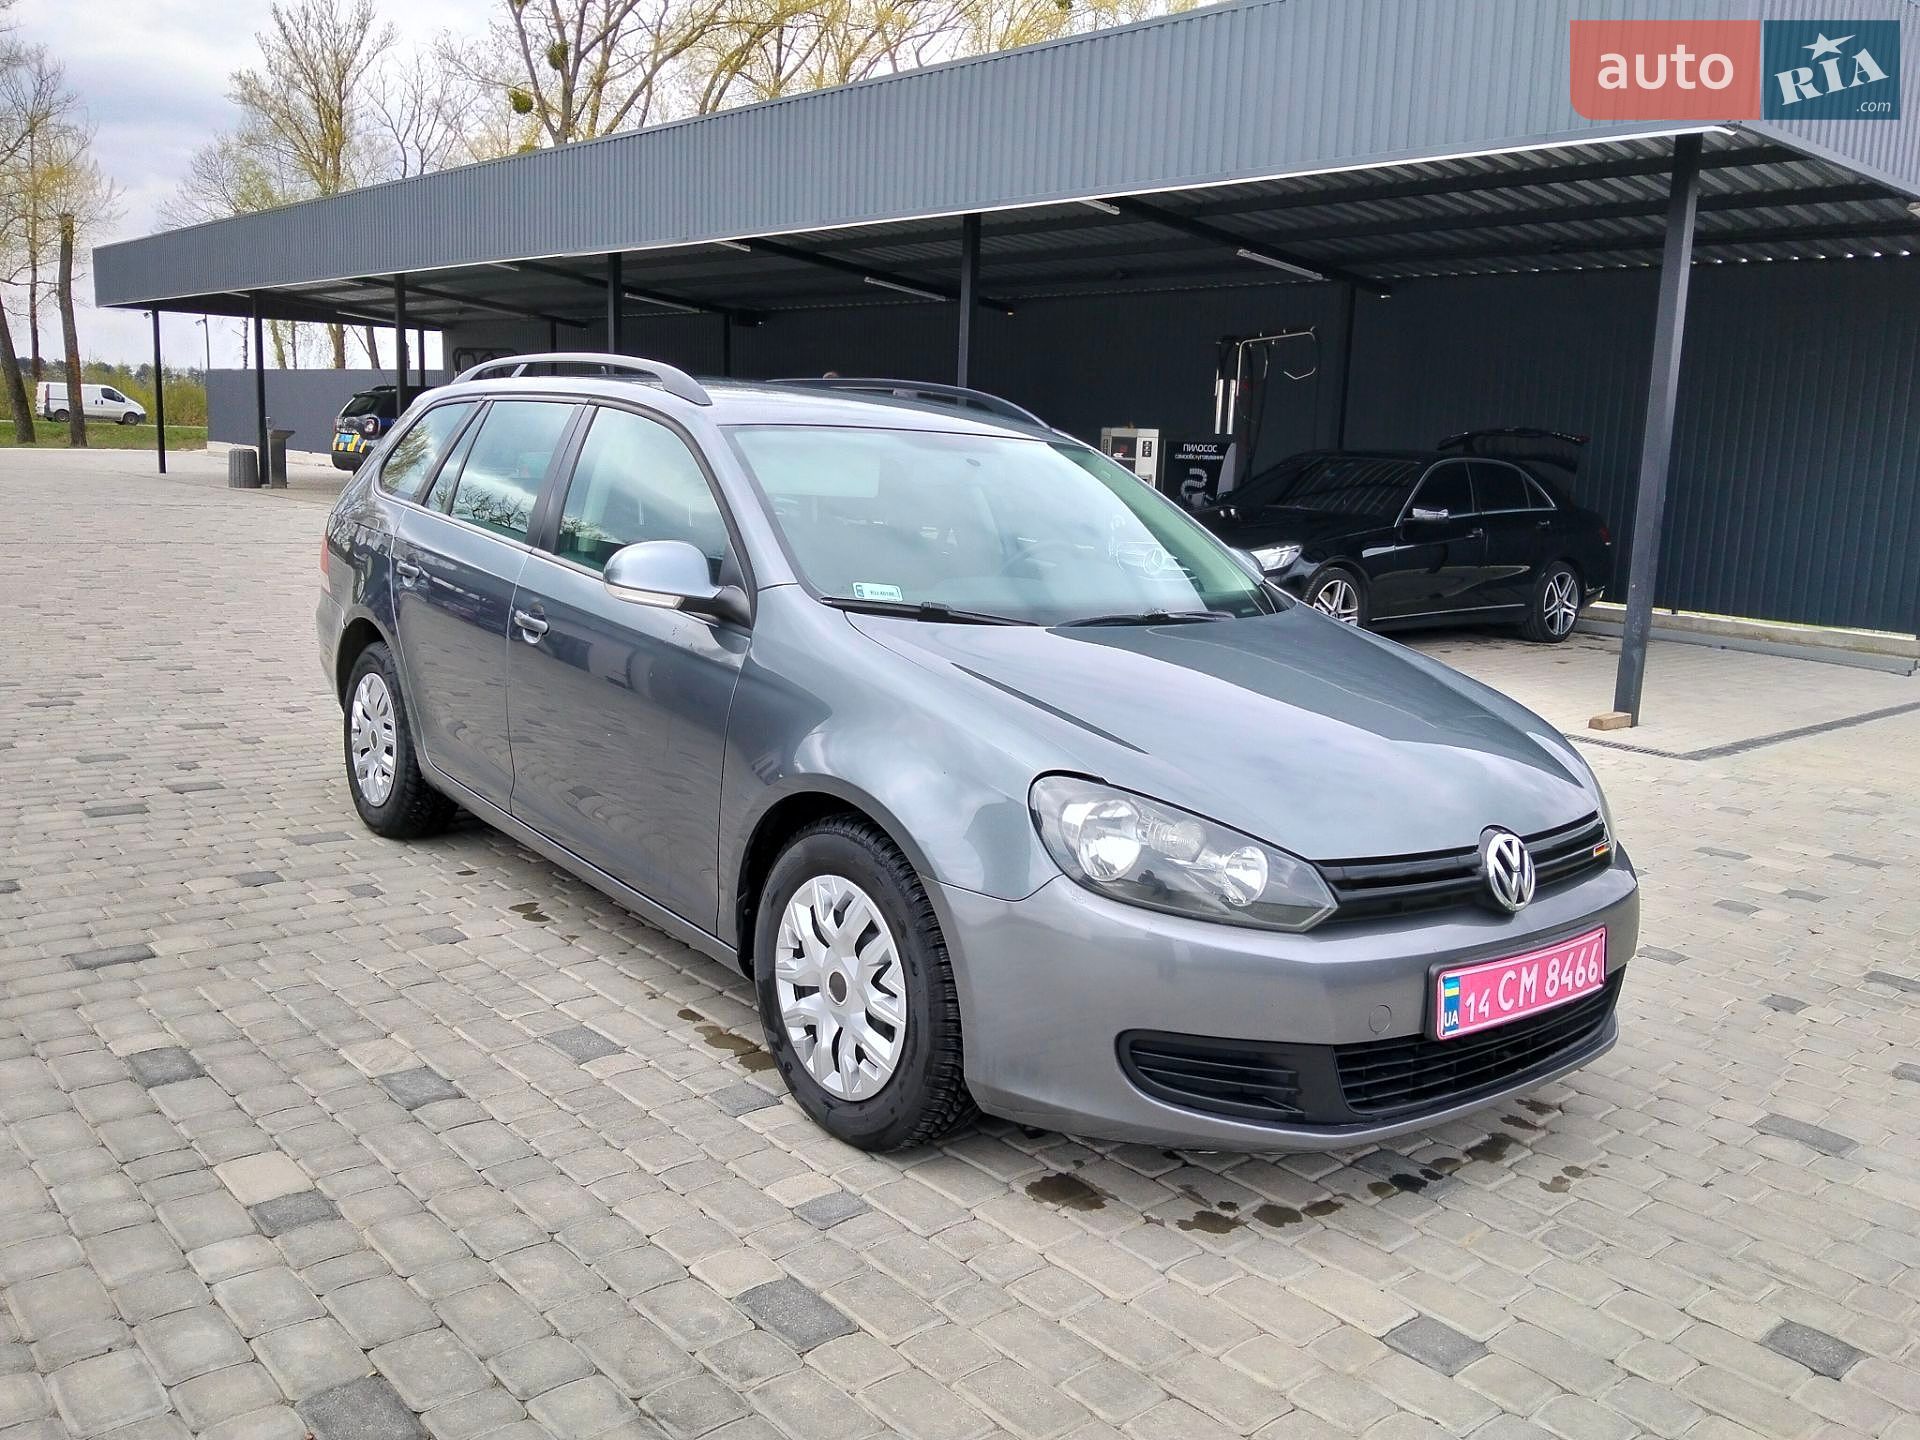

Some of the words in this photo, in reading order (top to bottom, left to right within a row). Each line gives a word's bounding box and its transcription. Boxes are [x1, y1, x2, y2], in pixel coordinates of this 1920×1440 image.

[1182, 443, 1218, 453] ПИЛОСОС
[1465, 987, 1491, 1023] 14
[1497, 962, 1539, 1011] CM
[1544, 942, 1599, 998] 8466
[1444, 1010, 1460, 1027] UA
